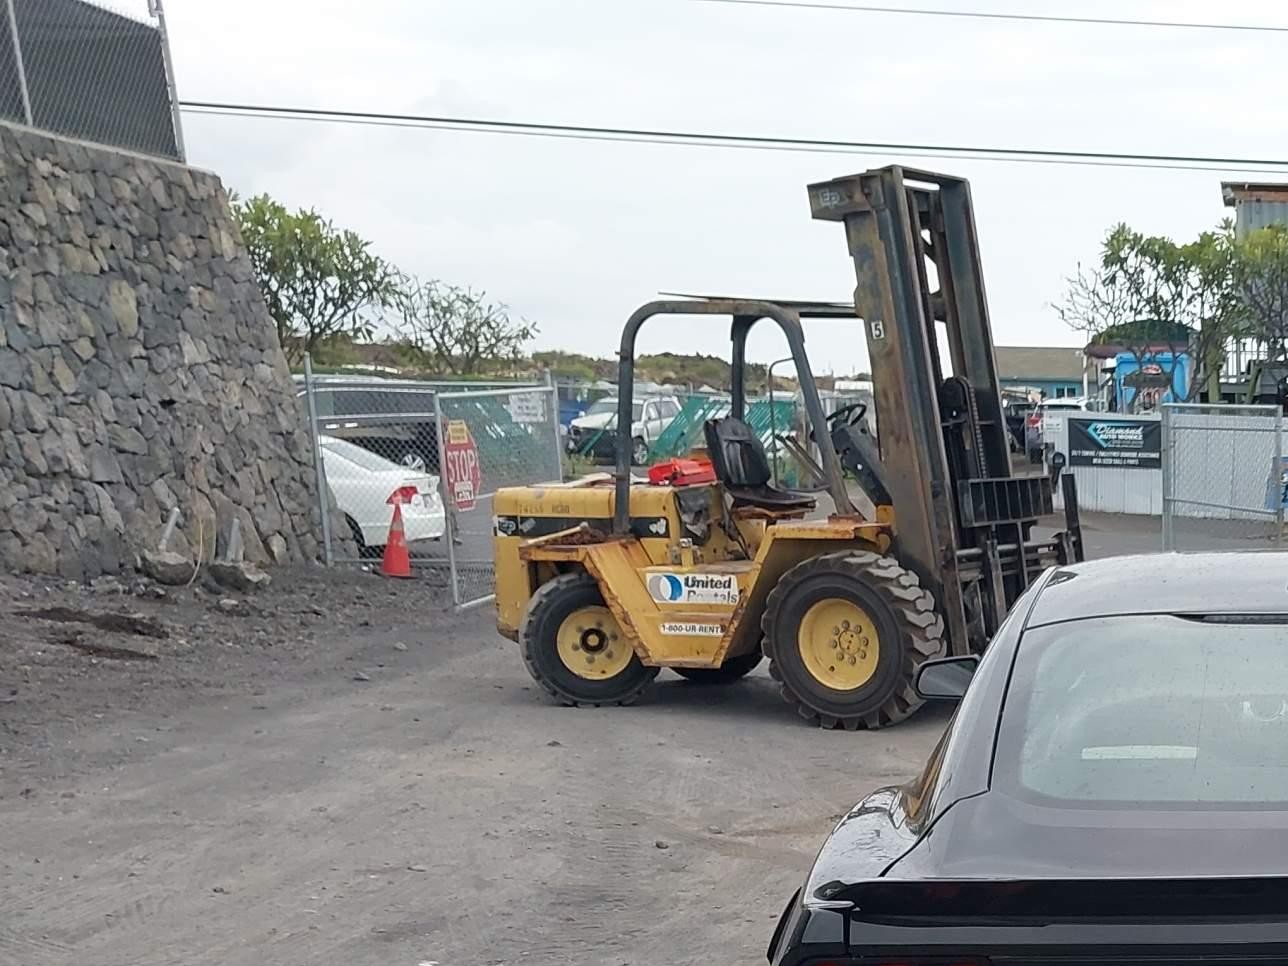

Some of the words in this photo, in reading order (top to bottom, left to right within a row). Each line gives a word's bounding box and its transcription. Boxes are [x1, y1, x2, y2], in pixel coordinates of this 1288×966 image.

[874, 323, 882, 338] 5
[1096, 424, 1144, 434] Diamond
[447, 449, 475, 483] STOP
[684, 575, 732, 589] United
